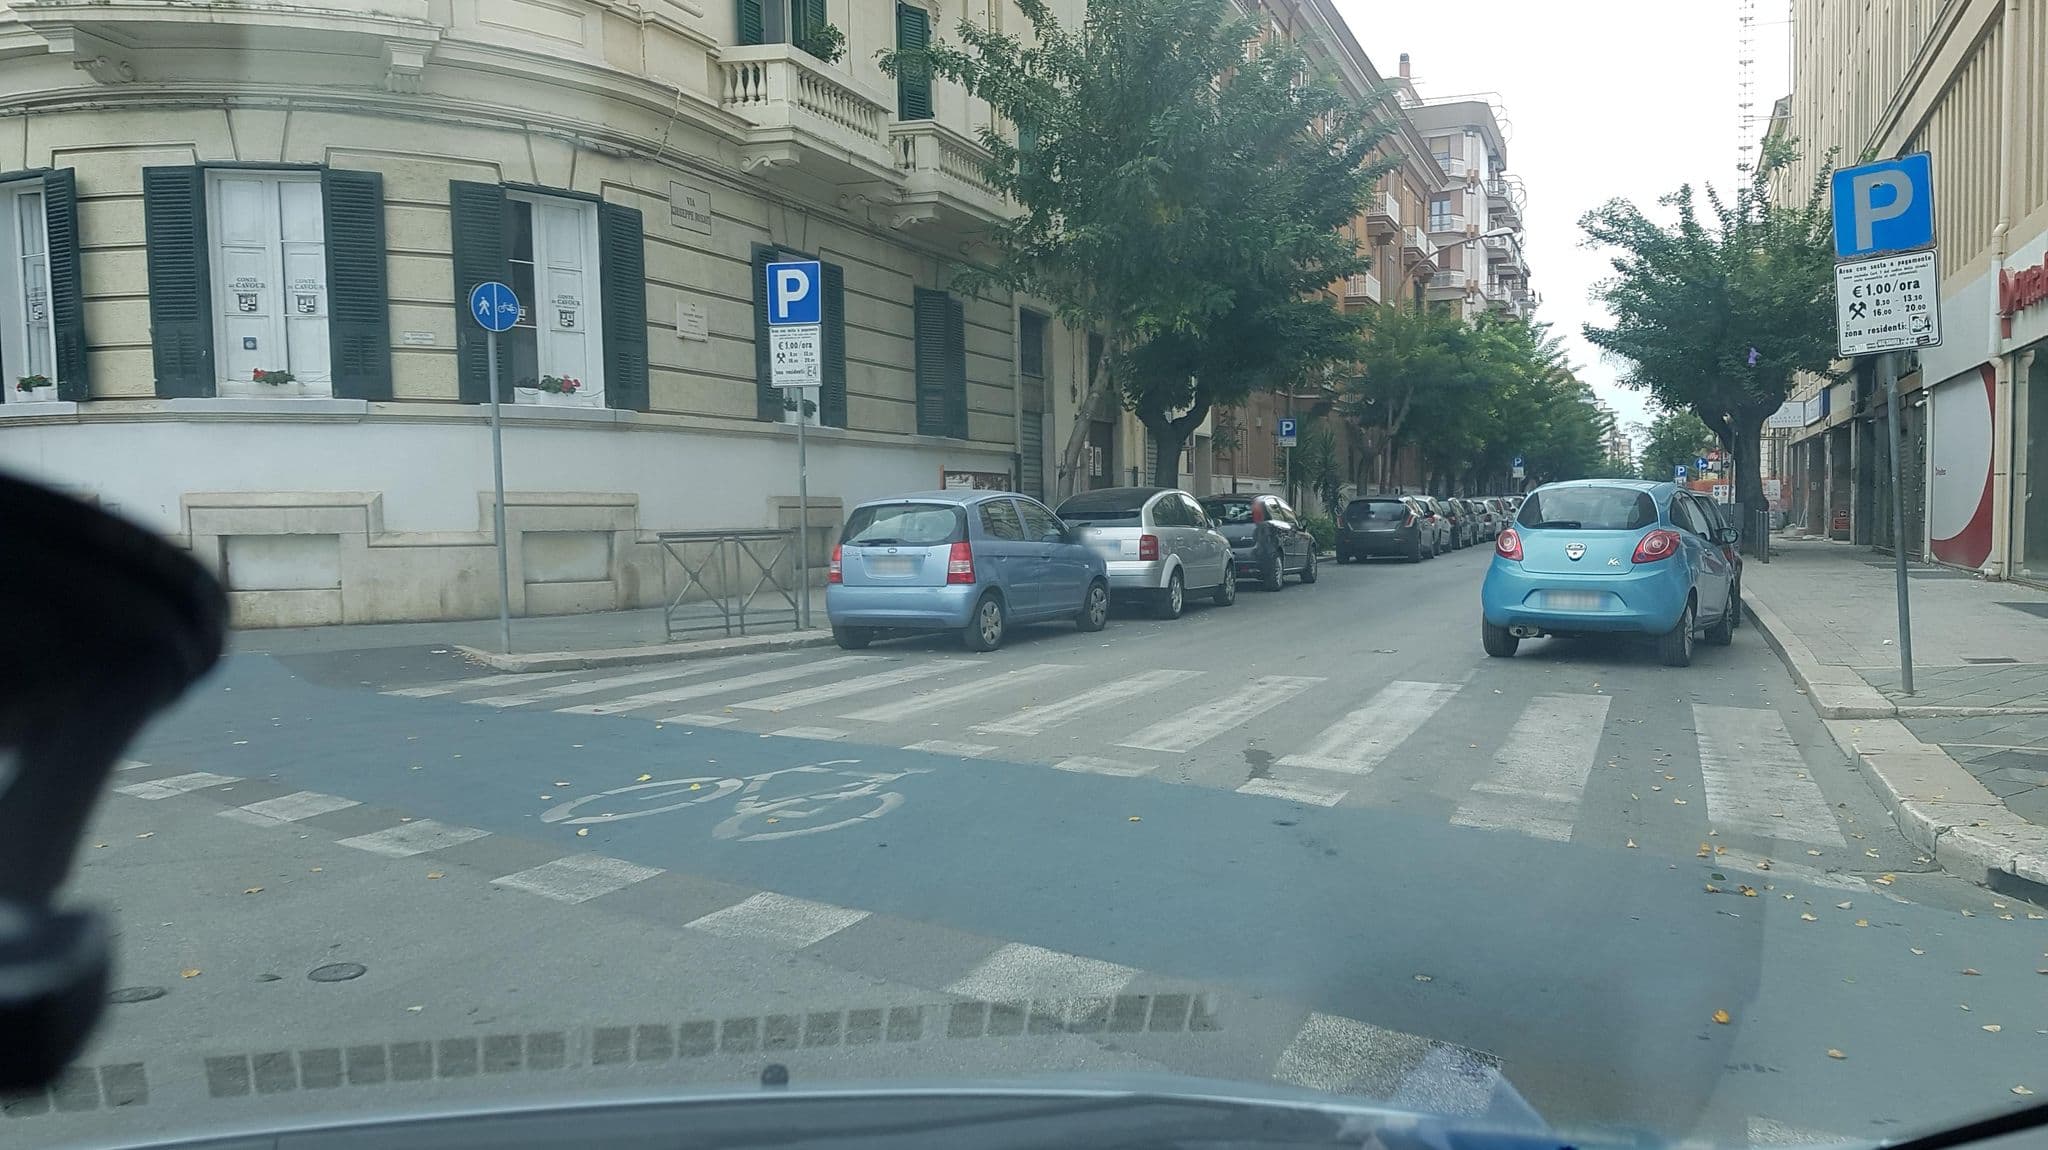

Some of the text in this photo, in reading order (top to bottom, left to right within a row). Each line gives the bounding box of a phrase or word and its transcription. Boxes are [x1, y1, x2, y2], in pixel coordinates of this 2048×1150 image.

[686, 196, 696, 207] VIA
[1853, 169, 1914, 251] P
[1839, 267, 1853, 275] Area
[1897, 254, 1932, 266] pagamento
[777, 269, 809, 318] P
[1905, 303, 1926, 313] 20.00
[1844, 328, 1863, 338] zona
[808, 366, 816, 377] E4
[1282, 421, 1294, 436] P
[1514, 457, 1522, 466] P
[1677, 466, 1686, 476] P
